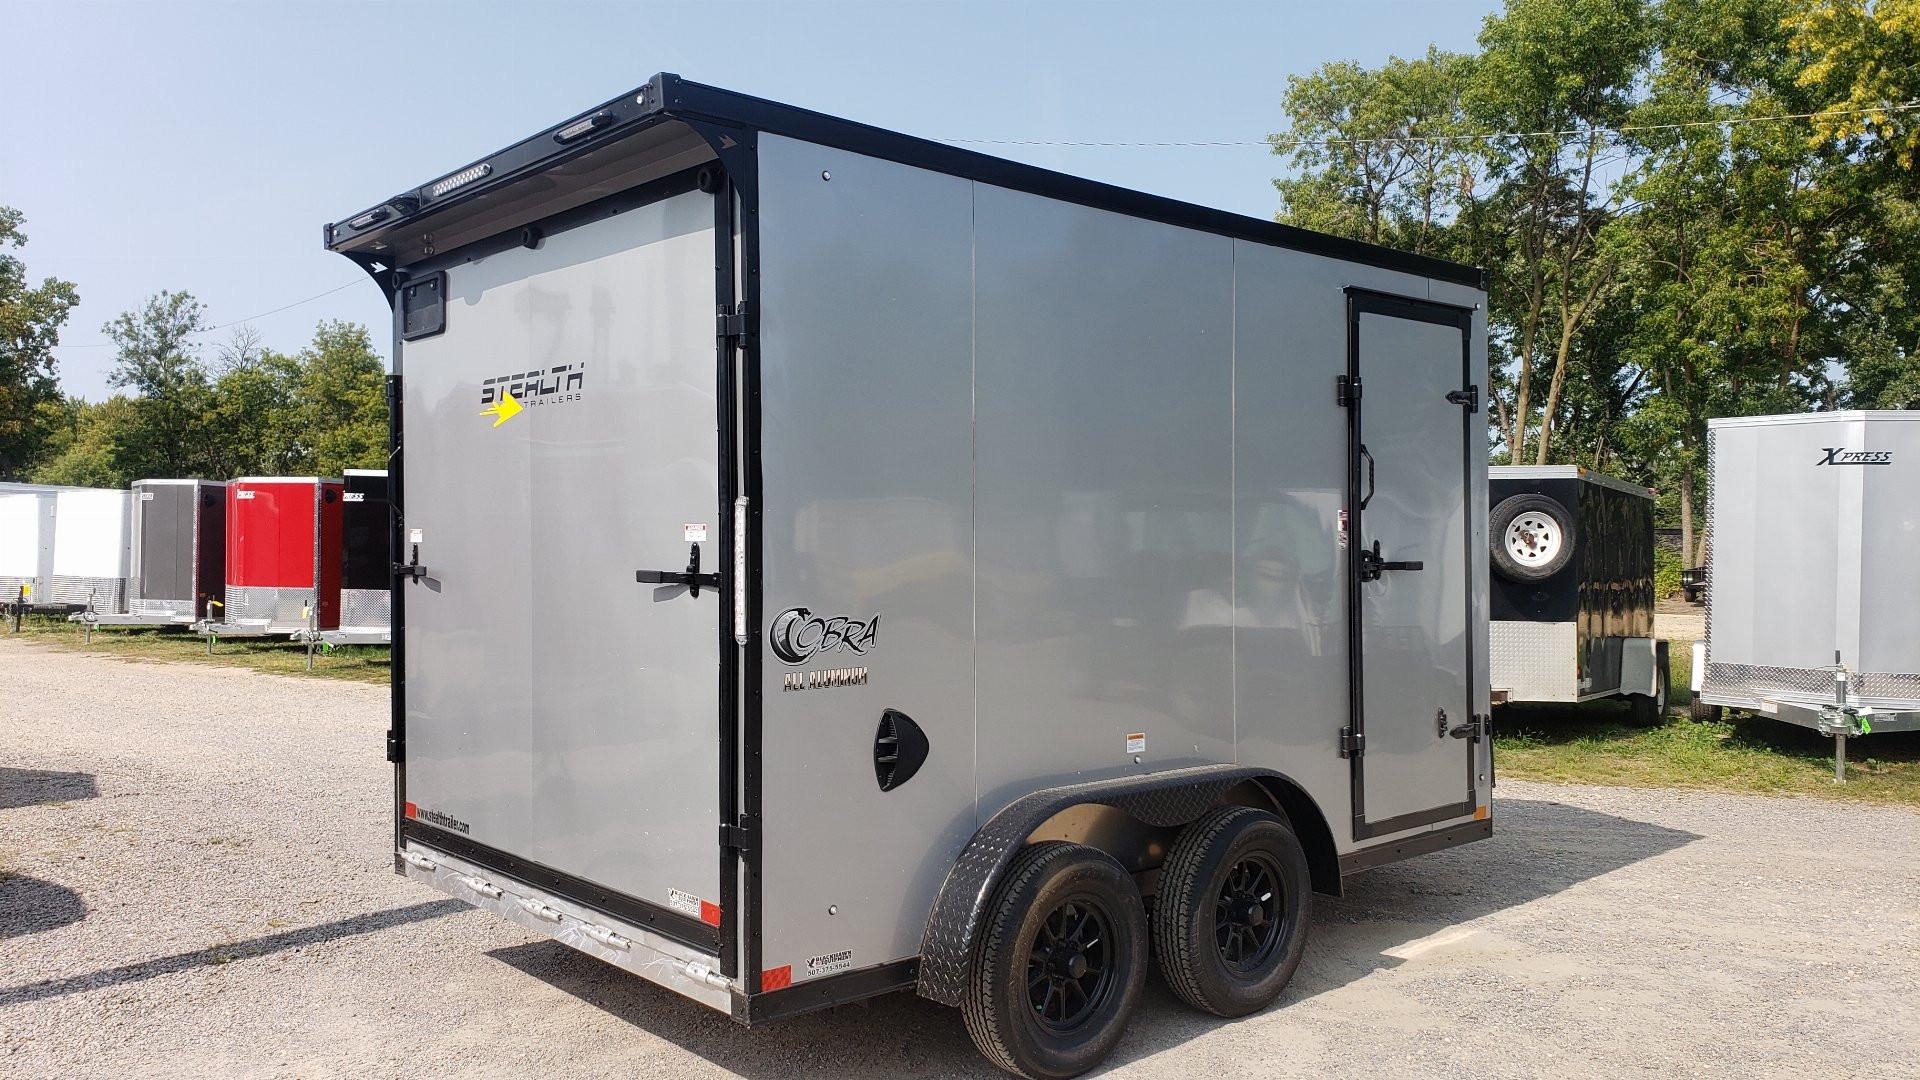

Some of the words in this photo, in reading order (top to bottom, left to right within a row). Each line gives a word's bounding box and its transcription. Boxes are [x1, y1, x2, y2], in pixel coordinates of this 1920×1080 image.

[480, 361, 585, 404] STEALTH
[523, 393, 582, 409] TRAILERS
[1815, 447, 1893, 466] XPRESS
[769, 606, 881, 666] COBRA
[783, 671, 806, 692] ALL
[808, 666, 868, 690] ALUMINUM
